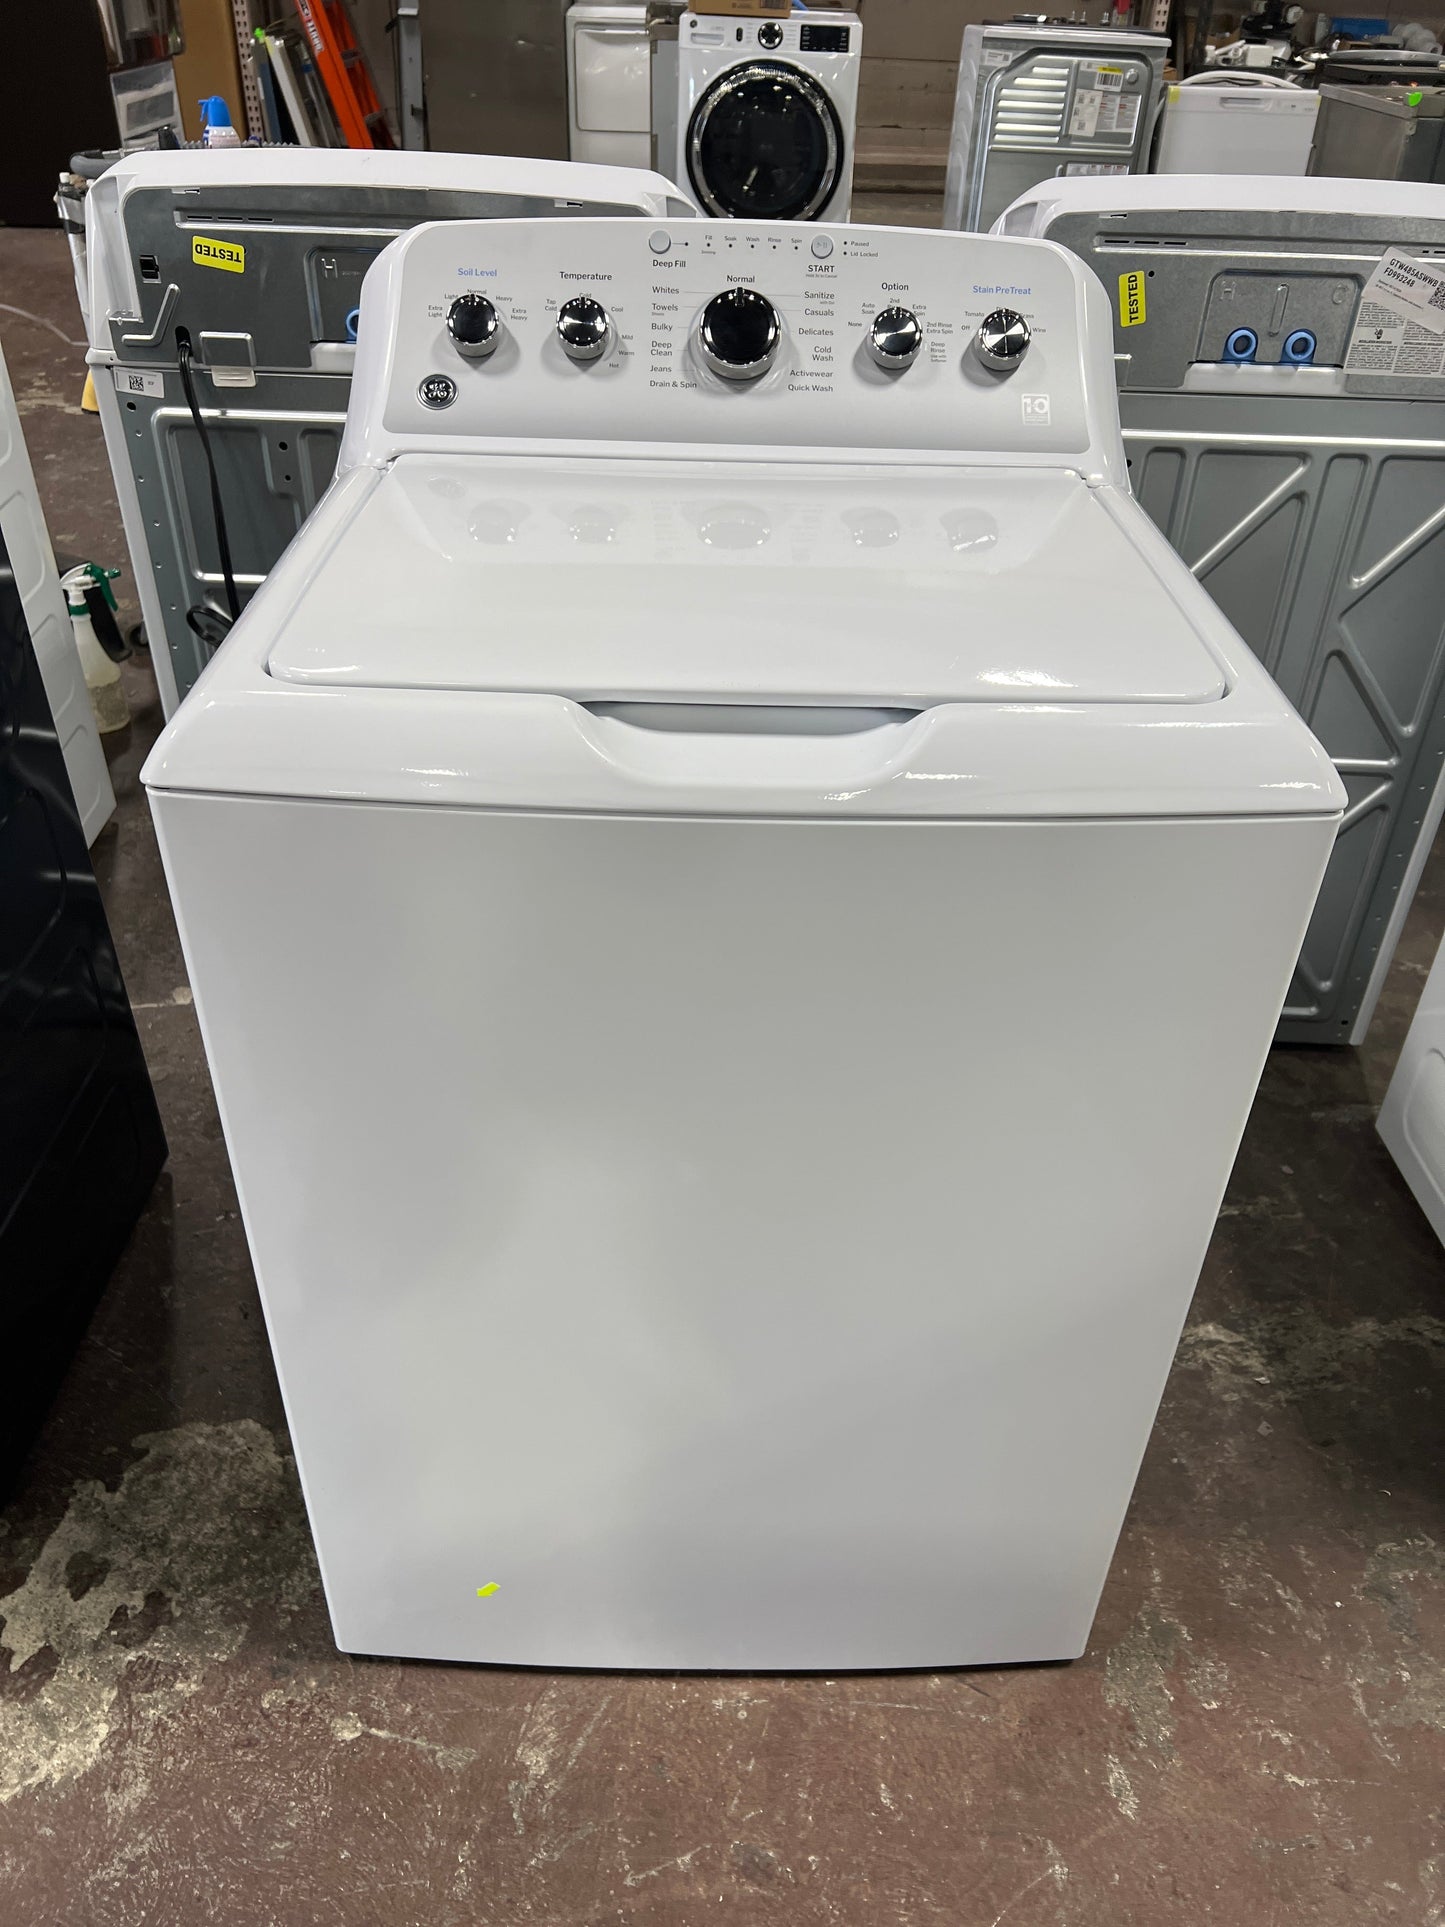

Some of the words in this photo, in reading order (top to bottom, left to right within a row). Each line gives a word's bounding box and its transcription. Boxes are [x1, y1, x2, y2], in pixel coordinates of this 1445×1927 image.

[195, 244, 242, 263] TESTED
[652, 260, 673, 268] Deep
[458, 268, 472, 276] Soil
[476, 268, 497, 277] Level
[560, 272, 612, 280] Temperature
[727, 274, 755, 283] Normal
[882, 282, 909, 291] Option
[973, 286, 994, 294] Stain
[996, 286, 1031, 295] PreTreat
[804, 291, 835, 300] Sanitize
[1128, 274, 1139, 324] TESTED
[652, 303, 678, 311] Towels
[652, 323, 672, 332] Bulky
[790, 370, 833, 378] Activewear
